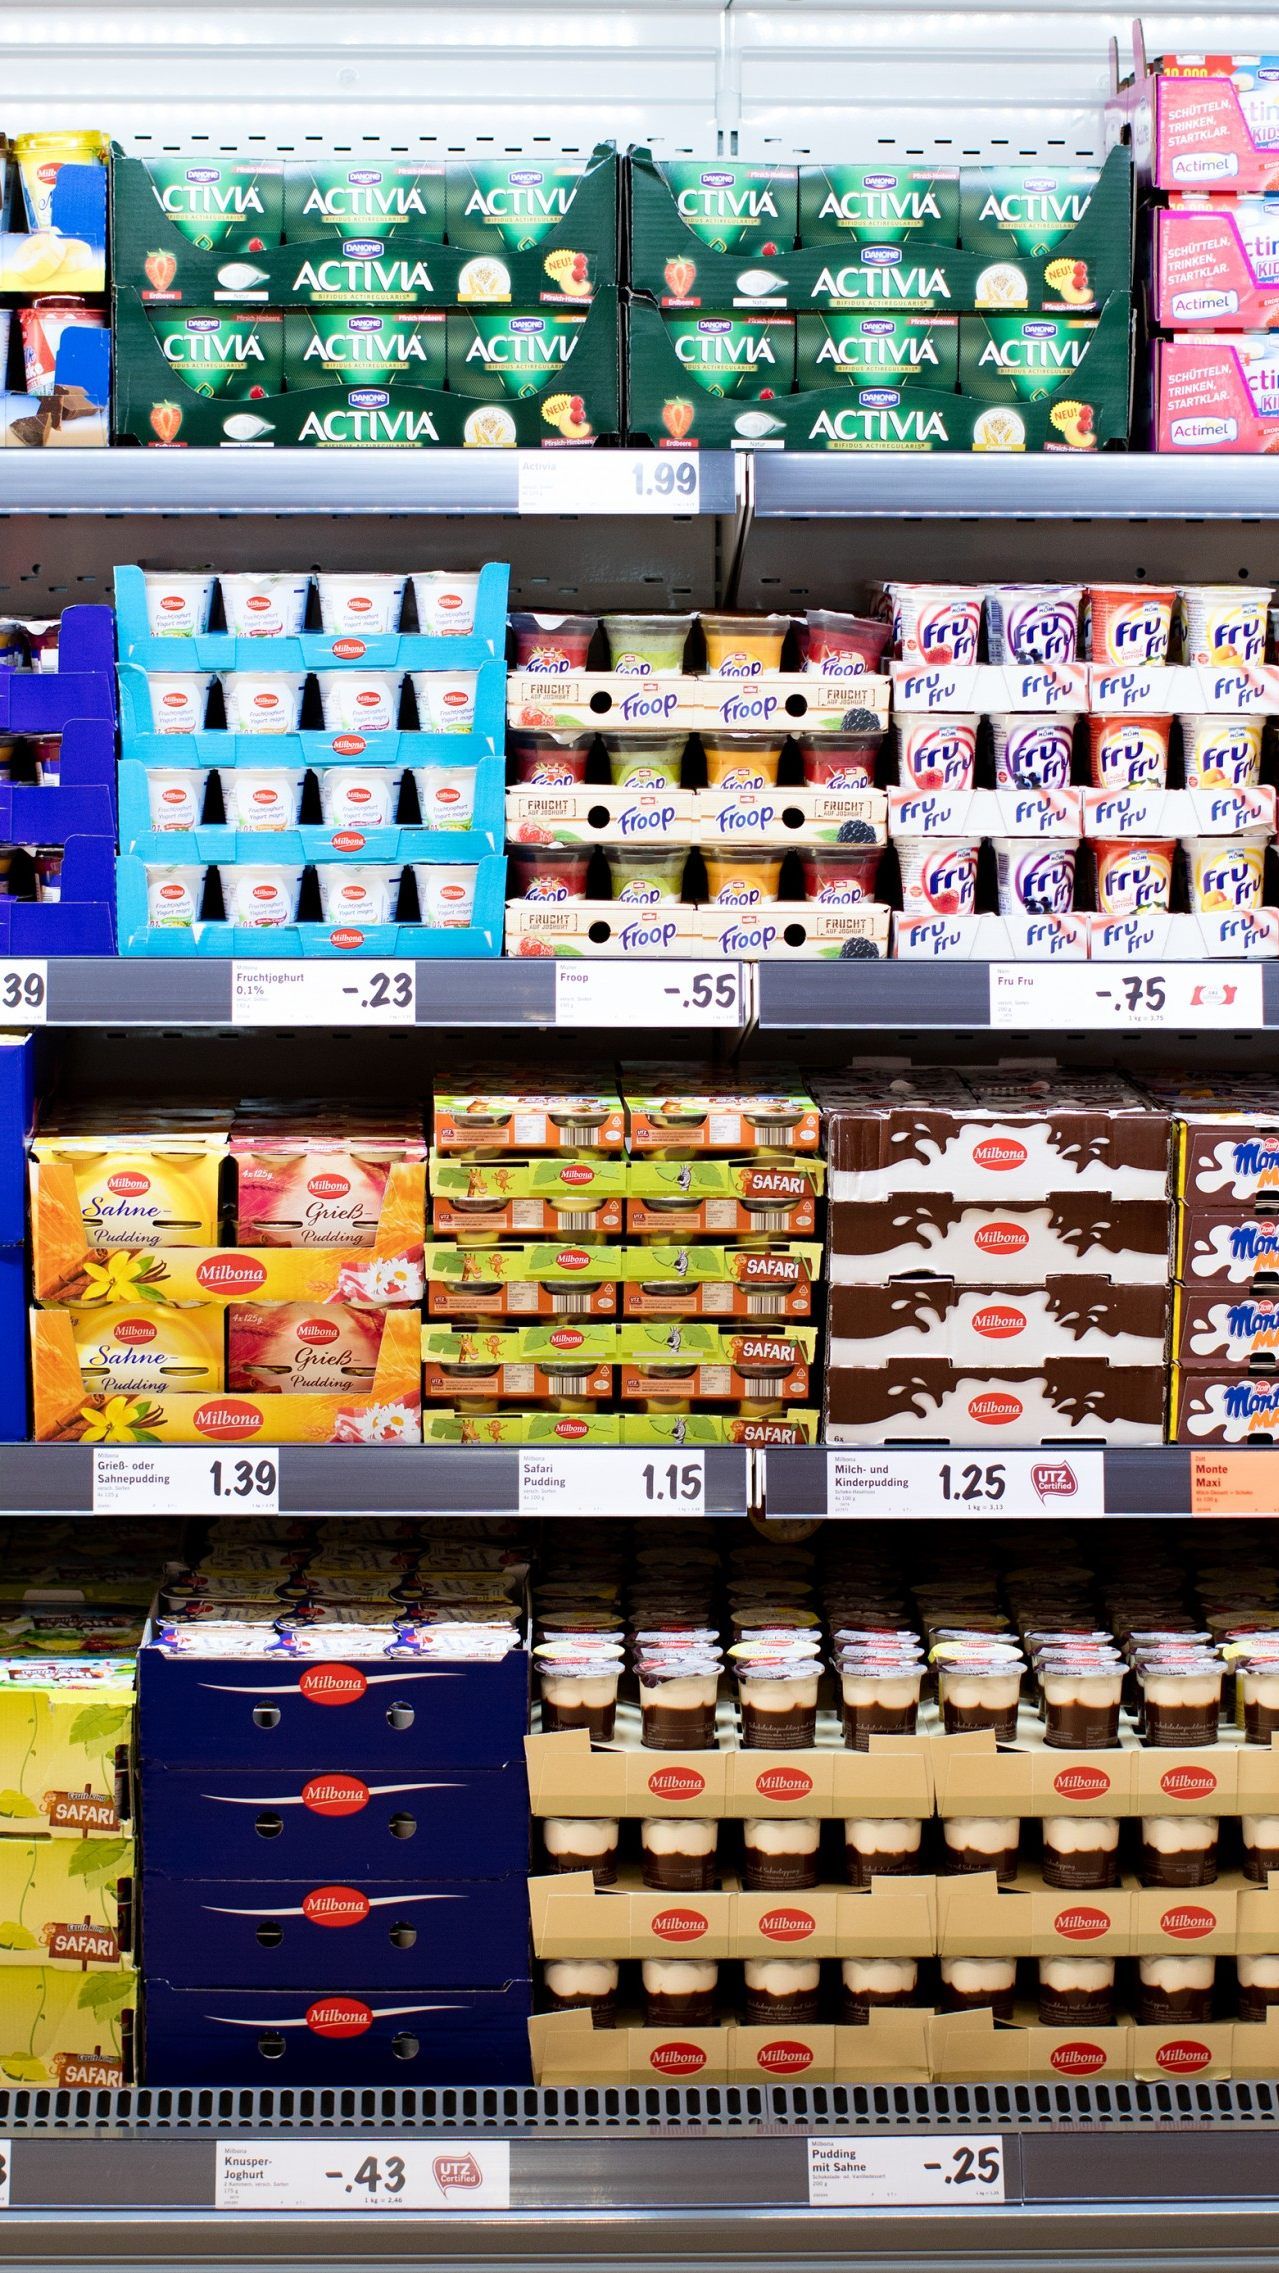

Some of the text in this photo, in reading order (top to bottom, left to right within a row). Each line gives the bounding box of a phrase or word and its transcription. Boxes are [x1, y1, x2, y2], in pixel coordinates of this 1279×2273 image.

[1175, 158, 1229, 173] Actimel
[303, 187, 427, 216] ACTIVIA
[818, 192, 942, 219] ACTIVIA
[346, 244, 383, 254] DANONE
[864, 250, 900, 260] DANONE
[548, 257, 572, 271] NEU!
[292, 261, 434, 292] ACTIVIA
[1048, 265, 1072, 281] NEU!
[810, 267, 951, 299] ACTIVIA
[1175, 295, 1230, 311] Actimel
[303, 335, 427, 362] ACTIVIA
[815, 337, 940, 365] ACTIVIA
[351, 394, 388, 403] DANONE
[862, 393, 898, 403] DANONE
[545, 401, 569, 418] NEU!
[1054, 407, 1078, 421] NEU!
[298, 411, 440, 441] ACTIVIA
[808, 410, 949, 442] ACTIVIA
[1174, 423, 1229, 438] Actimel
[632, 462, 697, 496] 1.99
[827, 689, 868, 699] FRUCHT
[720, 695, 778, 724] Froop
[333, 740, 365, 751] Milbona
[528, 800, 568, 810] FRUCHT
[824, 801, 864, 811] FRUCHT
[617, 806, 675, 835] Froop
[716, 804, 774, 834] Froop
[333, 836, 364, 847] Milbona
[529, 914, 570, 924] FRUCHT
[826, 918, 867, 929] FRUCHT
[331, 933, 363, 944] Milbona
[618, 922, 676, 951] Froop
[719, 925, 776, 954] Froop
[236, 973, 305, 984] Fruchtjoghurt
[560, 973, 589, 984] Froop
[997, 976, 1034, 986] Fru Fru
[342, 972, 413, 1008] -.23
[663, 973, 737, 1009] -.55
[1095, 975, 1167, 1012] -.75
[974, 1147, 1026, 1160] Milbona
[561, 1170, 593, 1180] Milbona
[108, 1178, 150, 1189] Milbona
[307, 1180, 349, 1191] Milbona
[752, 1174, 805, 1194] SAFARI
[82, 1197, 172, 1218] Sahne-
[305, 1201, 373, 1226] Grieß-
[94, 1229, 162, 1247] Pudding
[301, 1230, 364, 1248] Pudding
[975, 1231, 1027, 1244] Milbona
[557, 1255, 589, 1265] Milbona
[199, 1265, 264, 1280] Milbona
[747, 1259, 799, 1279] SAFARI
[973, 1315, 1025, 1328] Milbona
[114, 1326, 155, 1336] Milbona
[297, 1326, 338, 1337] Milbona
[551, 1334, 583, 1345] Milbona
[89, 1345, 178, 1367] Sahne-
[743, 1342, 795, 1361] SAFARI
[294, 1347, 362, 1371] Grieß-
[101, 1377, 169, 1395] Pudding
[291, 1375, 353, 1391] Pudding
[970, 1402, 1021, 1415] Milbona
[196, 1410, 261, 1426] Milbona
[555, 1424, 587, 1433] Milbona
[744, 1427, 796, 1444] SAFARI
[98, 1461, 154, 1471] Grieß- oder
[524, 1464, 553, 1473] Safari
[835, 1464, 889, 1475] Milch- und
[1195, 1464, 1228, 1474] Monte
[97, 1474, 171, 1485] Sahnepudding
[210, 1460, 277, 1496] 1.39
[524, 1477, 566, 1488] Pudding
[642, 1464, 703, 1500] 1.15
[835, 1477, 910, 1489] Kinderpudding
[939, 1464, 1006, 1501] 1.25
[1038, 1470, 1066, 1483] UTZ
[1196, 1478, 1221, 1487] Maxi
[1038, 1481, 1072, 1490] Certified
[304, 1676, 362, 1691] Milbona
[650, 1775, 703, 1789] Milbona
[758, 1775, 811, 1790] Milbona
[1055, 1775, 1108, 1789] Milbona
[1162, 1774, 1215, 1788] Milbona
[306, 1786, 364, 1801] Milbona
[55, 1803, 114, 1825] SAFARI
[307, 1898, 365, 1913] Milbona
[653, 1917, 706, 1931] Milbona
[761, 1917, 814, 1931] Milbona
[1056, 1916, 1108, 1930] Milbona
[1162, 1915, 1214, 1929] Milbona
[55, 1935, 114, 1957] SAFARI
[311, 2009, 368, 2024] Milbona
[652, 2050, 704, 2064] Milbona
[758, 2049, 812, 2063] Milbona
[65, 2065, 123, 2087] SAFARI
[812, 2149, 857, 2160] Pudding
[224, 2157, 273, 2169] Knusper-
[440, 2163, 470, 2175] UTZ
[812, 2162, 867, 2172] mit Sahne
[924, 2146, 1000, 2185] -.25
[224, 2170, 265, 2182] Joghurt
[325, 2155, 406, 2193] -.43
[440, 2174, 476, 2183] Certified
